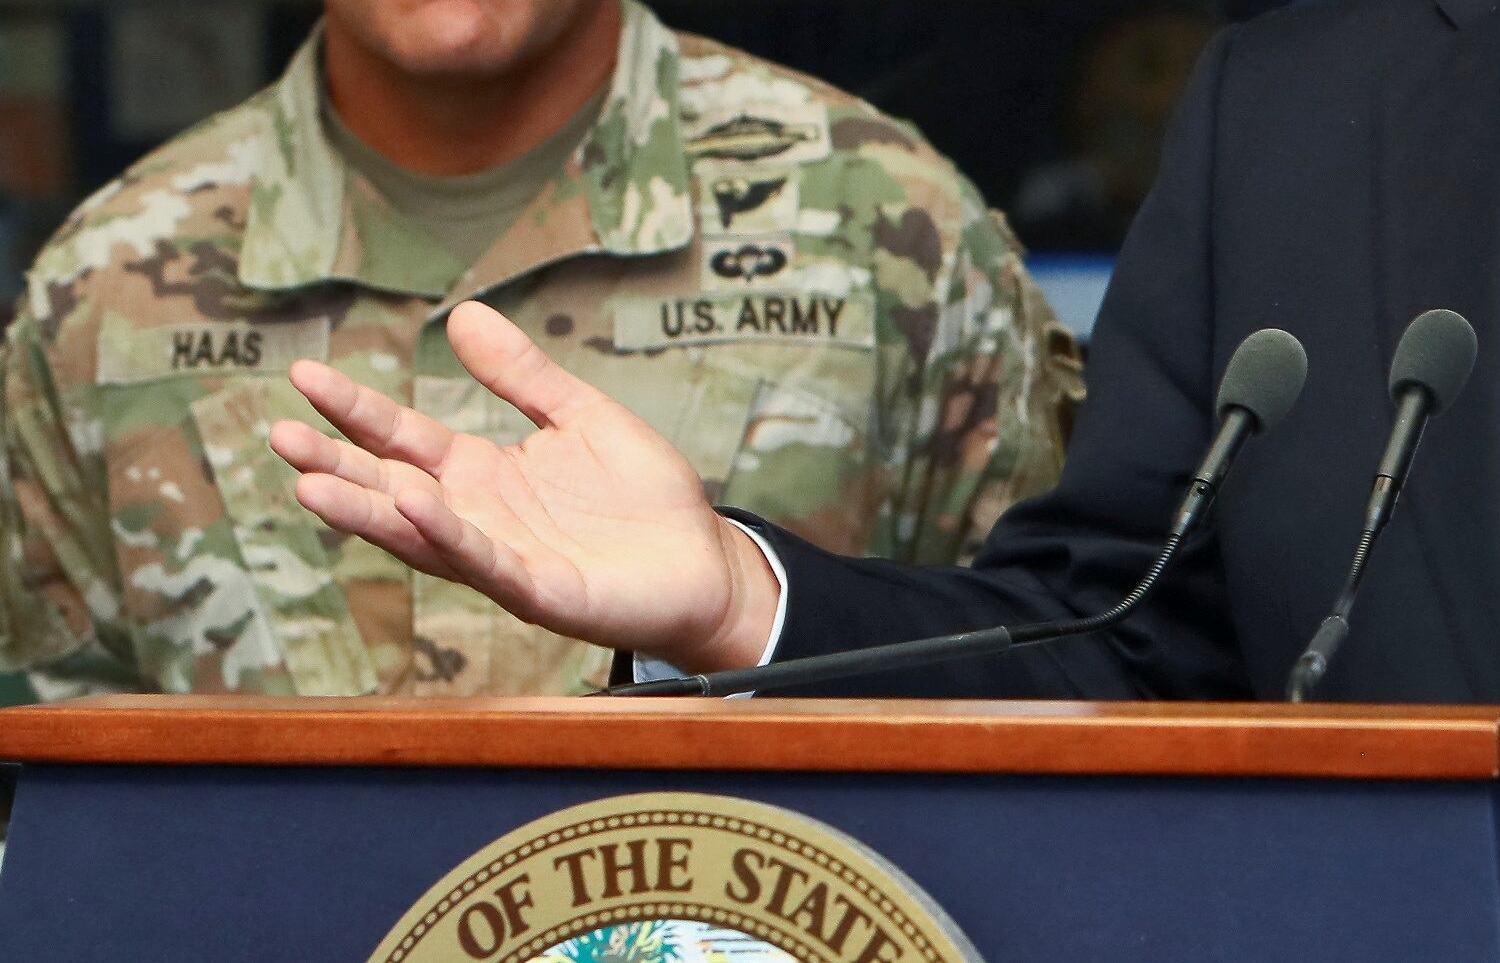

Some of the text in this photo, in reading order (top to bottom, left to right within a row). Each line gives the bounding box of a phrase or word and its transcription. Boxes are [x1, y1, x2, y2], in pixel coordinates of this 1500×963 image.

[661, 295, 846, 337] U.S. ARMY
[171, 329, 263, 370] HAAS
[457, 872, 535, 960] OF
[553, 837, 694, 908] THE
